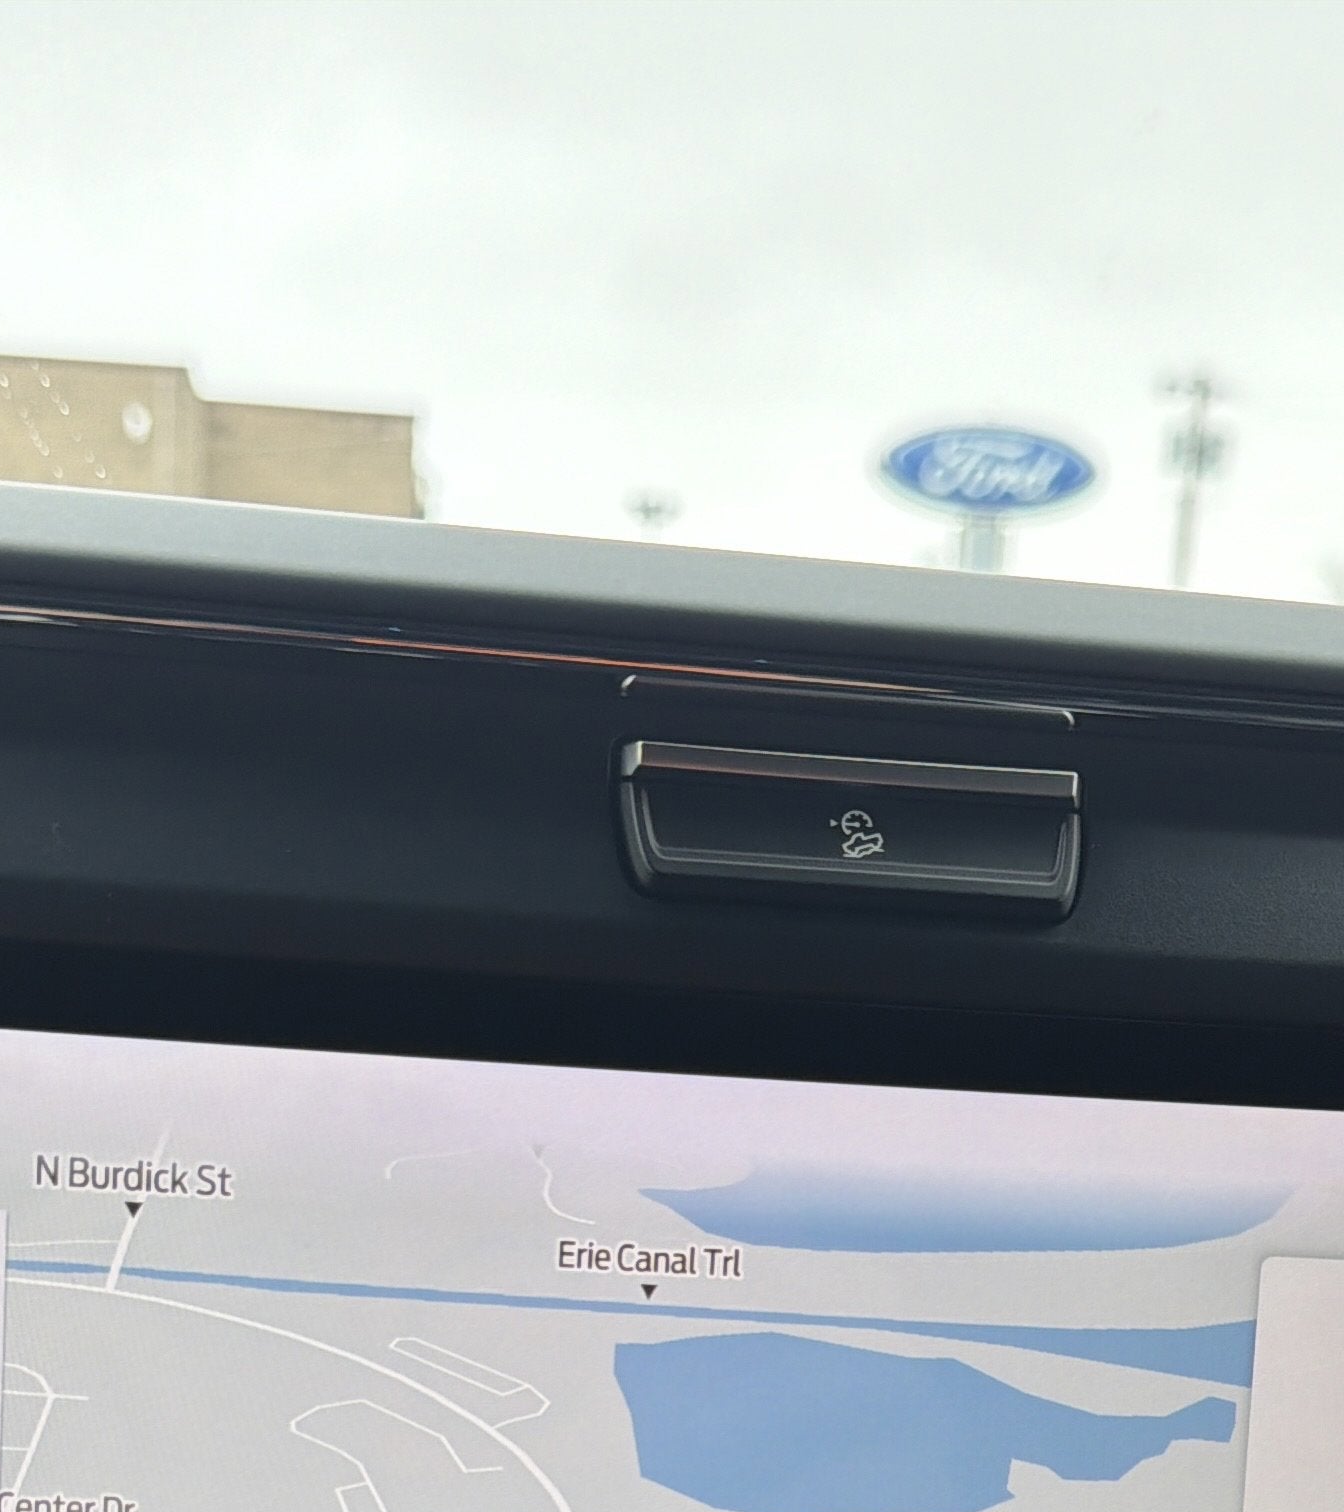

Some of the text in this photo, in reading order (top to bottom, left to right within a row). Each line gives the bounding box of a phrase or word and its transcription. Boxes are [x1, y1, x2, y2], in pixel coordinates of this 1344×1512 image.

[918, 438, 1066, 501] Ford
[35, 1155, 233, 1197] N Burdick St
[558, 1240, 741, 1278] Erie Canal Trl
